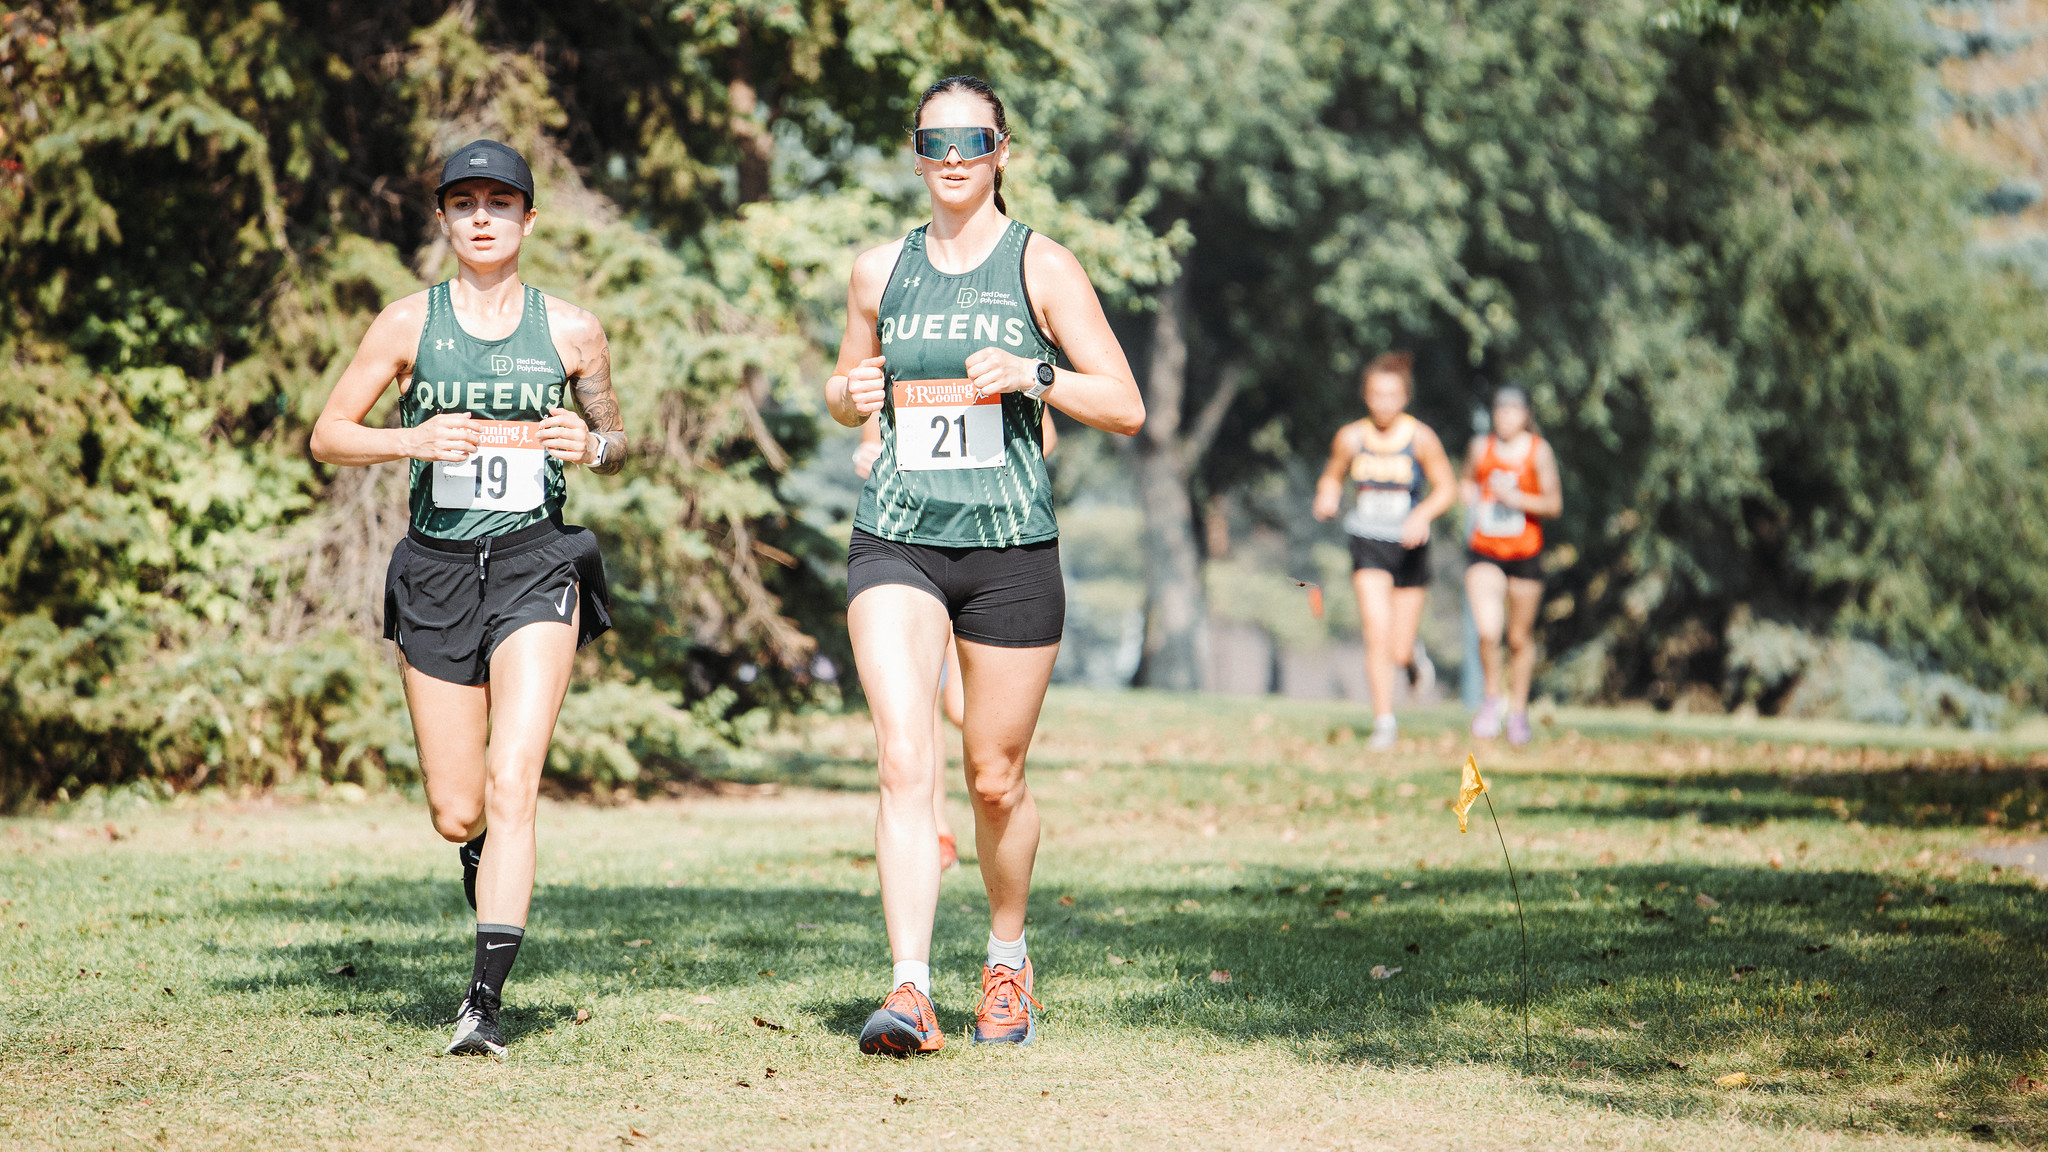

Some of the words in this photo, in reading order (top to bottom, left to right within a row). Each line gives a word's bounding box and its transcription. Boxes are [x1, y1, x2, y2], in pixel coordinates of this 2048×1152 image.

[980, 297, 1018, 307] Polytechnic
[994, 291, 1010, 299] Deer
[881, 314, 1025, 347] QUEENS
[516, 365, 555, 374] Polytechnic
[530, 358, 546, 366] Deer
[416, 381, 562, 411] QUEENS
[915, 382, 974, 404] Running
[930, 414, 968, 459] 21
[470, 455, 508, 500] 19
